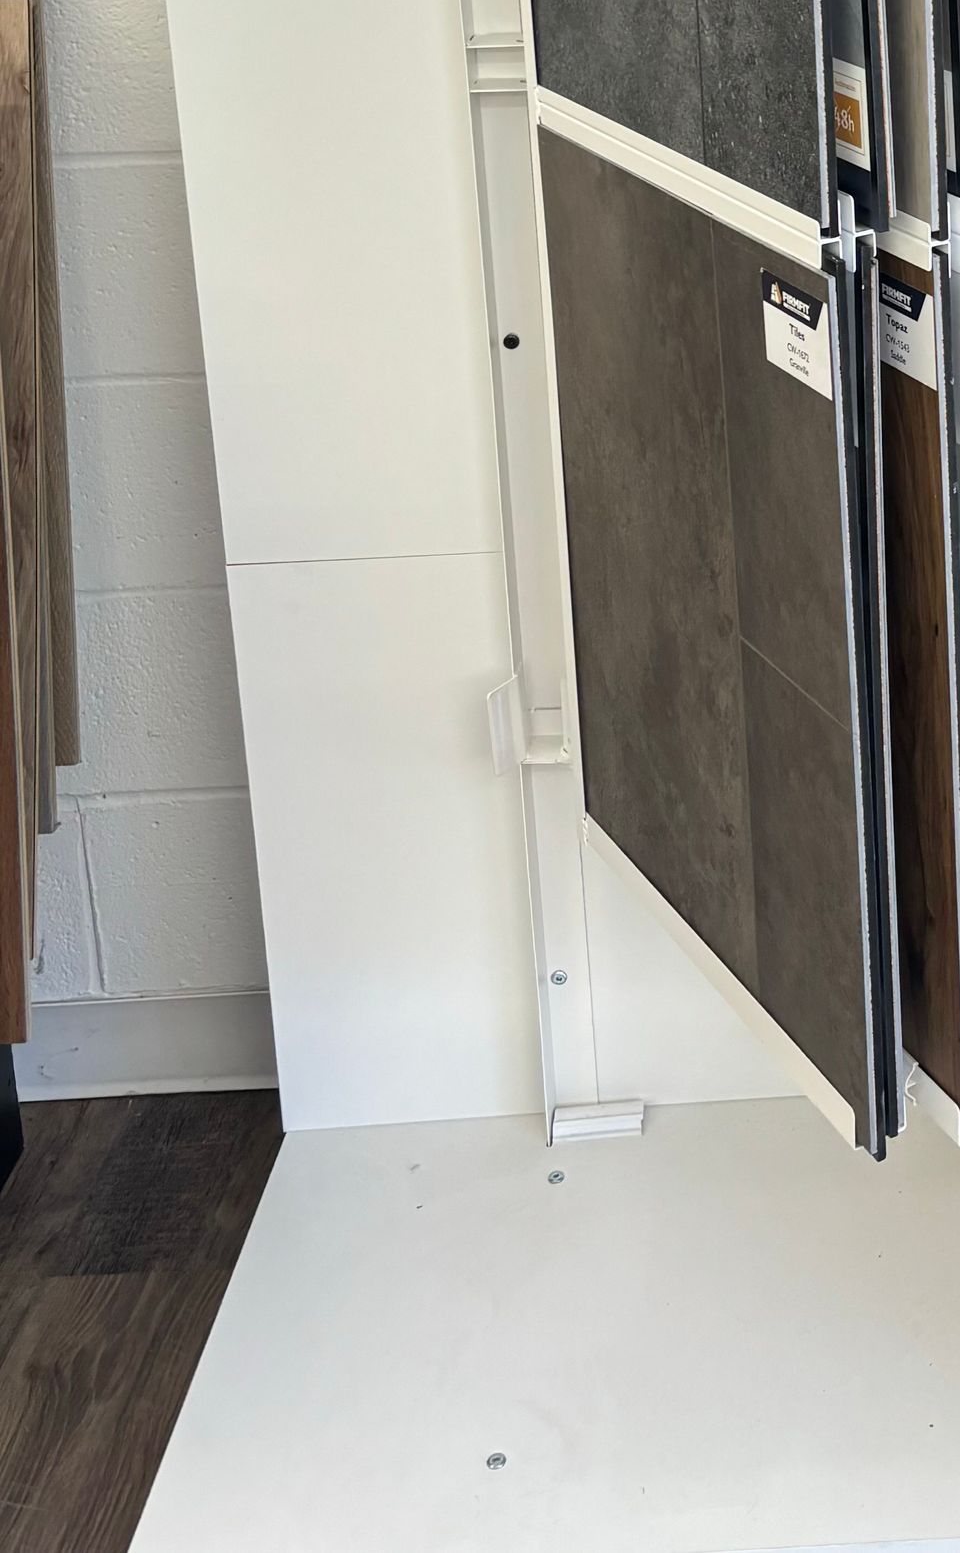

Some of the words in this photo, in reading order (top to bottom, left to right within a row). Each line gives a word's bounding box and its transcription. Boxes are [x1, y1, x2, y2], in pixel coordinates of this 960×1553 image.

[782, 290, 811, 315] FIRMFIT
[881, 282, 911, 307] FIRMFIT
[789, 323, 805, 341] Tiles
[886, 313, 908, 333] Topaz
